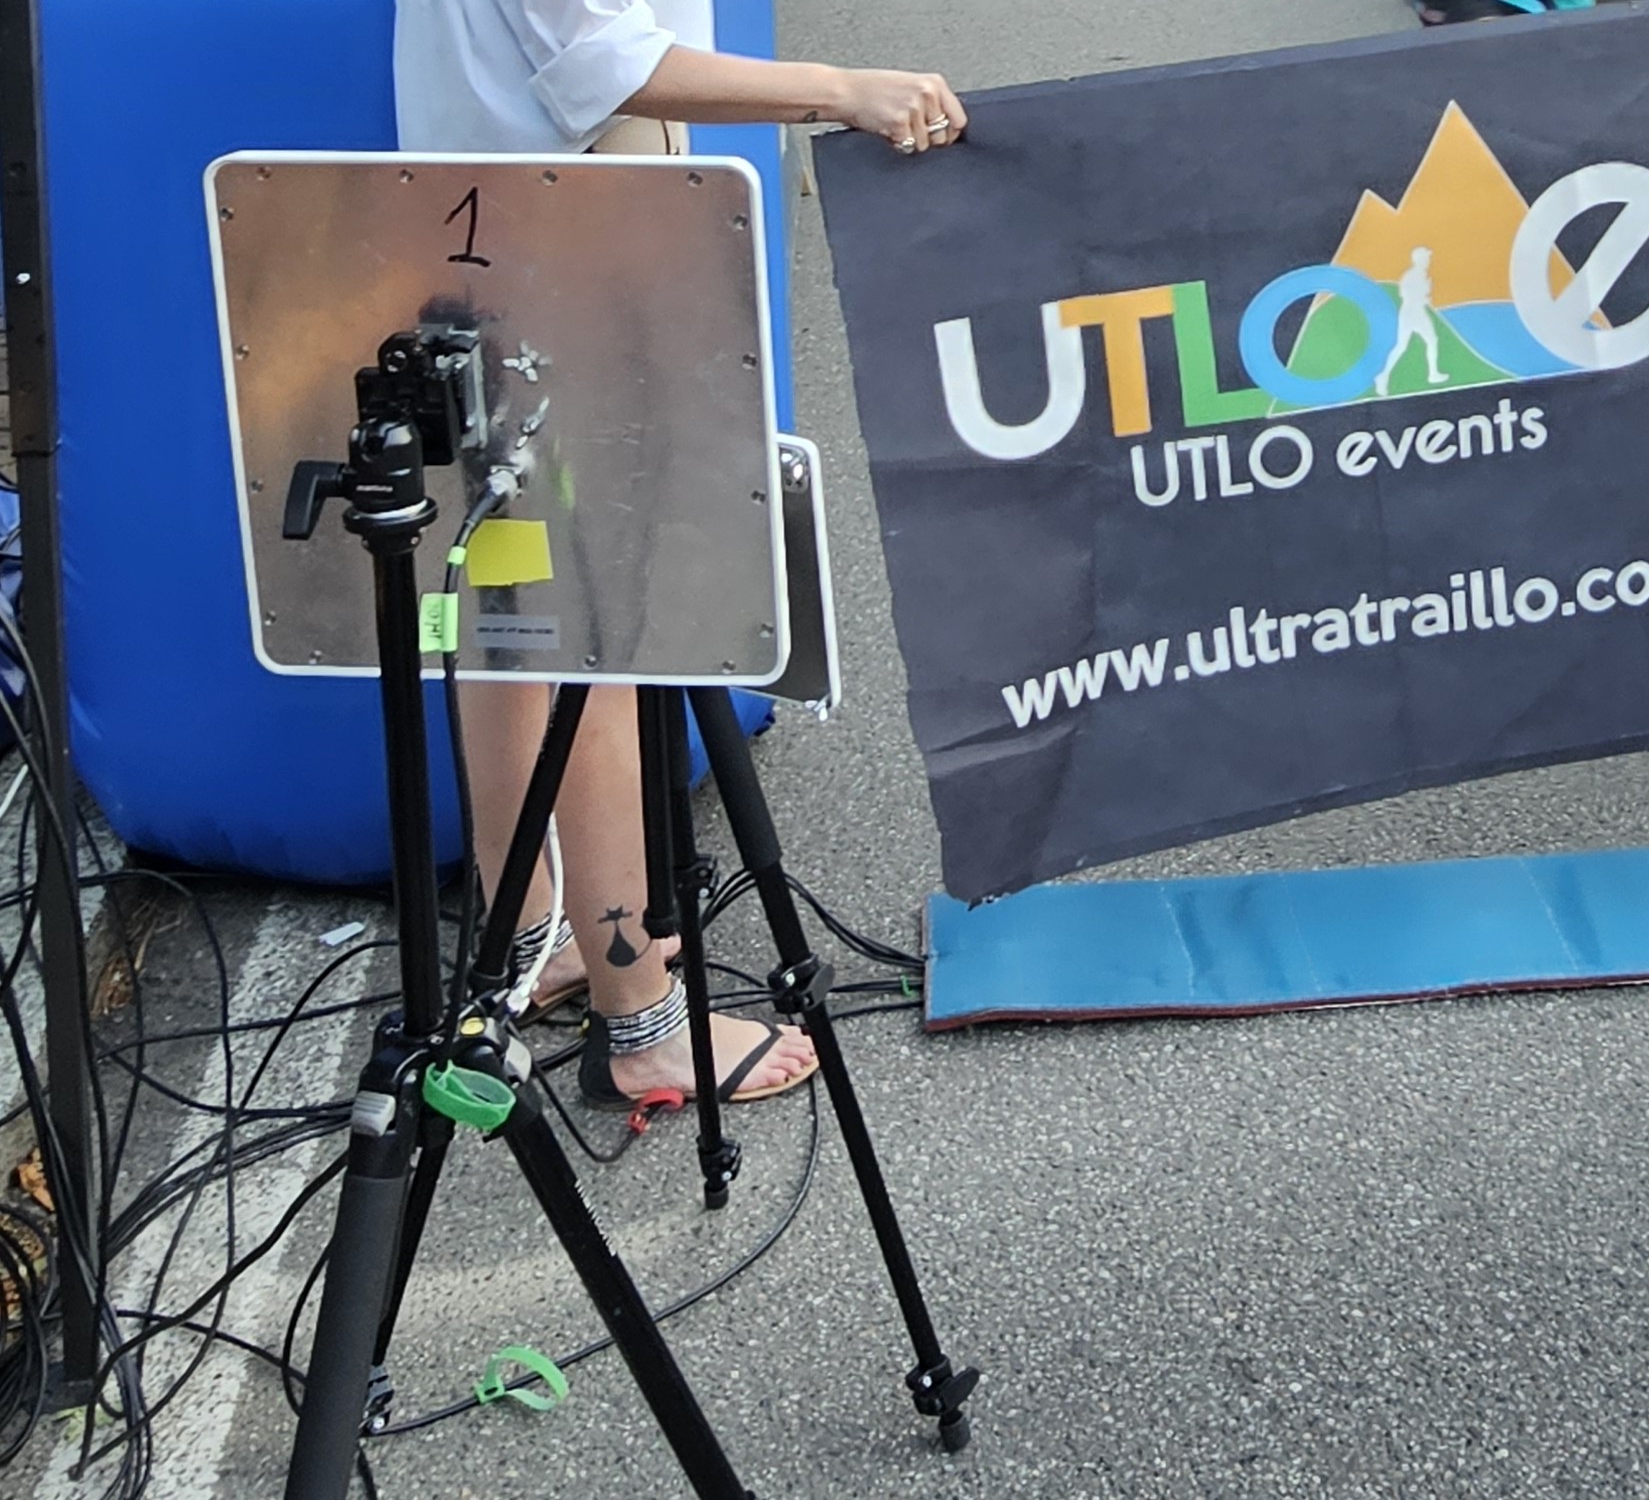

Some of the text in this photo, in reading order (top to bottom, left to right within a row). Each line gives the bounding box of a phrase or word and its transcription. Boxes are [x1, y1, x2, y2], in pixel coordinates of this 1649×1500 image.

[444, 185, 491, 268] 1
[1129, 397, 1549, 507] UTLO events
